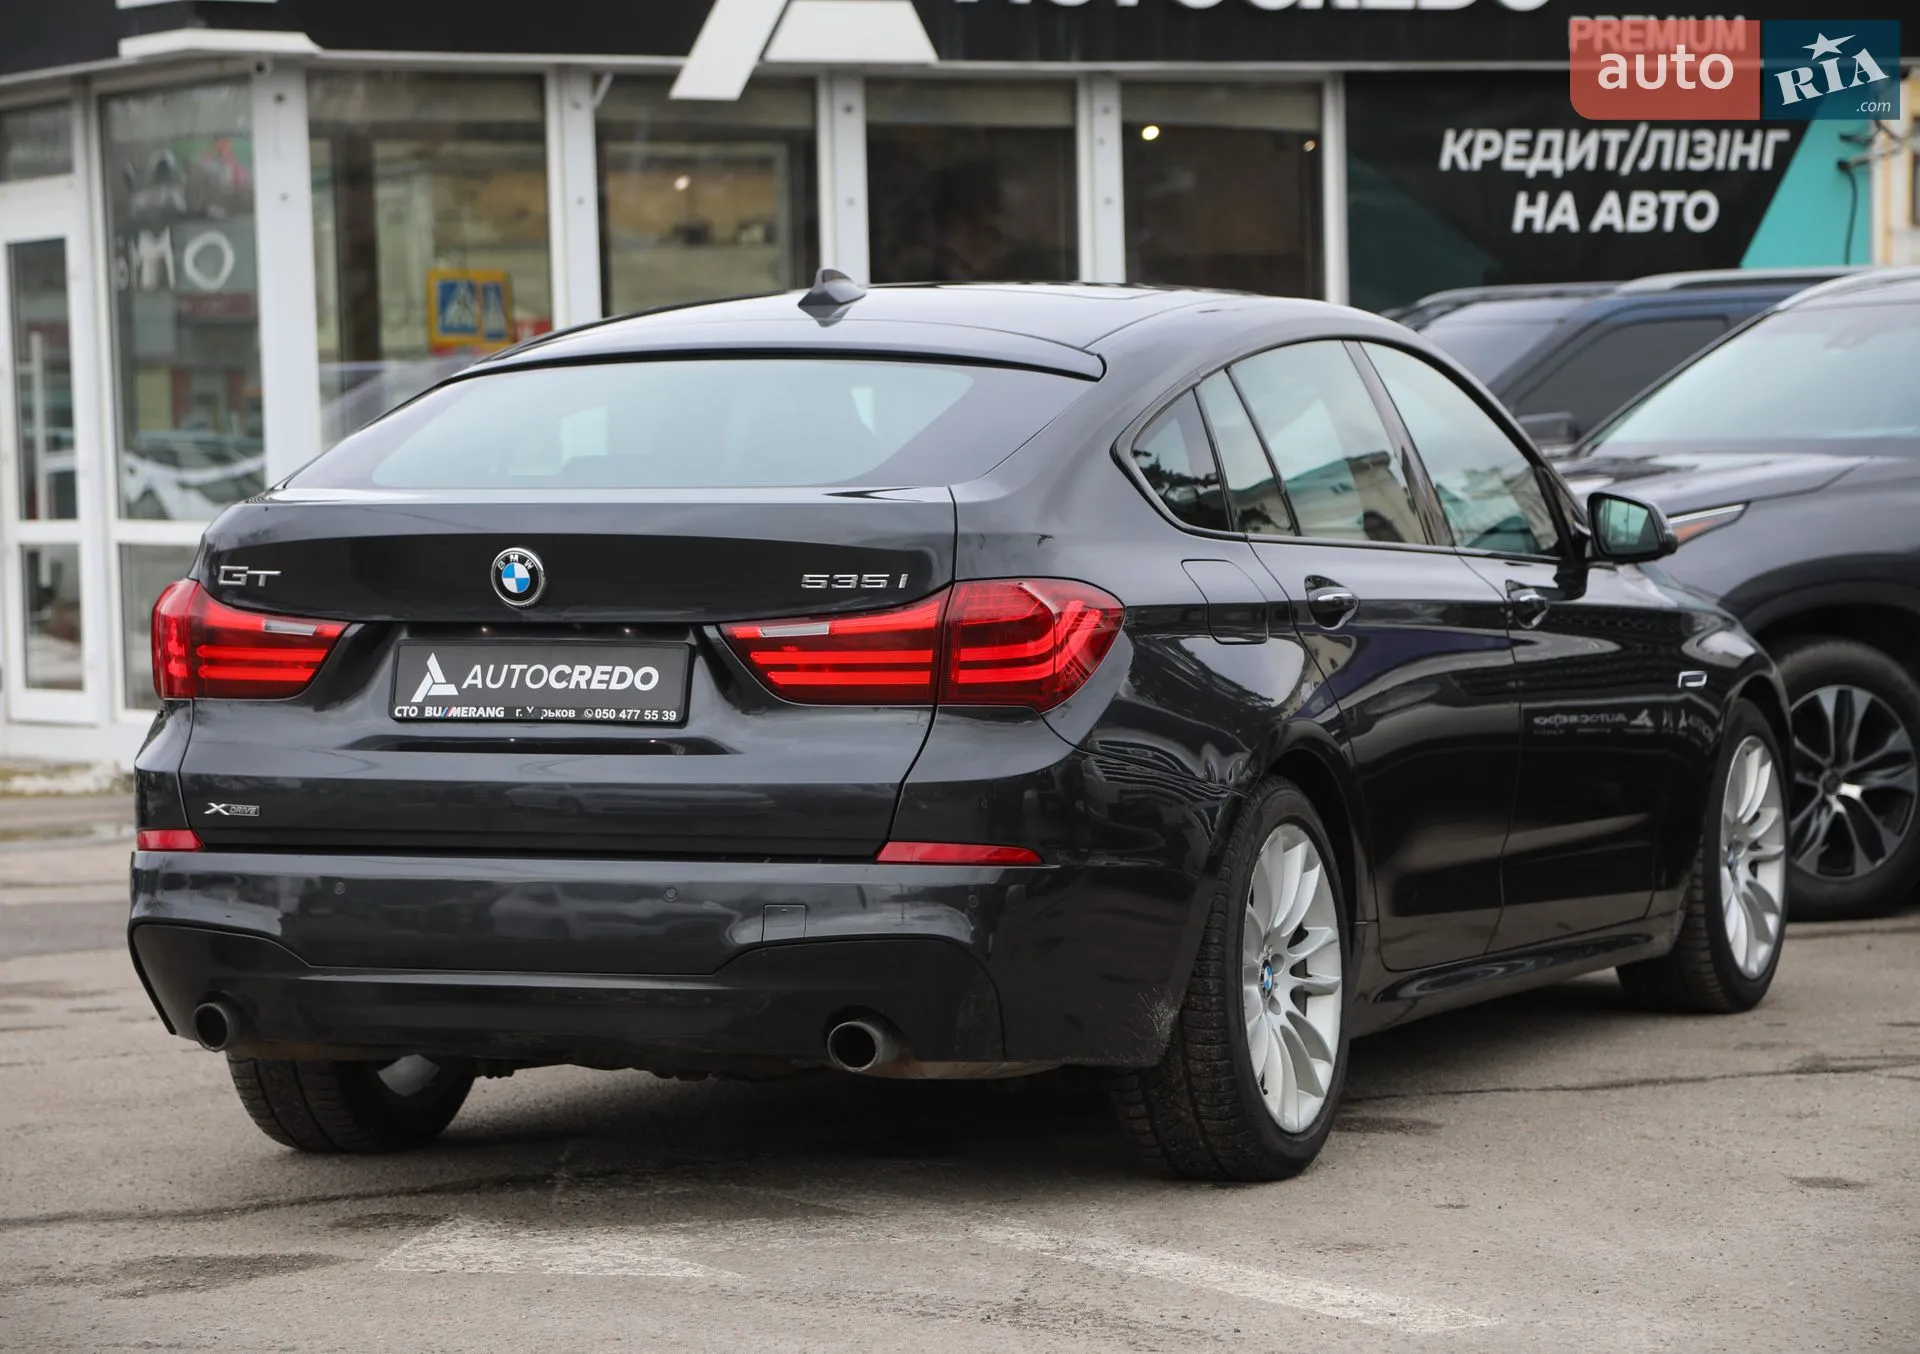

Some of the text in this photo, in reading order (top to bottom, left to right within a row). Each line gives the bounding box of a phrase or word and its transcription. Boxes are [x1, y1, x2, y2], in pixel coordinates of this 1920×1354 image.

[1569, 15, 1747, 51] PREMIUM
[1438, 122, 1790, 178] КРЕДИТ/ЛІЗІНГ
[1511, 189, 1720, 233] НА АВТО
[218, 565, 282, 587] GT
[801, 573, 890, 589] 535
[461, 664, 660, 692] AUTOCREDO
[594, 708, 616, 720] 050
[618, 709, 641, 720] 477
[644, 709, 660, 721] 55
[661, 710, 678, 722] 39
